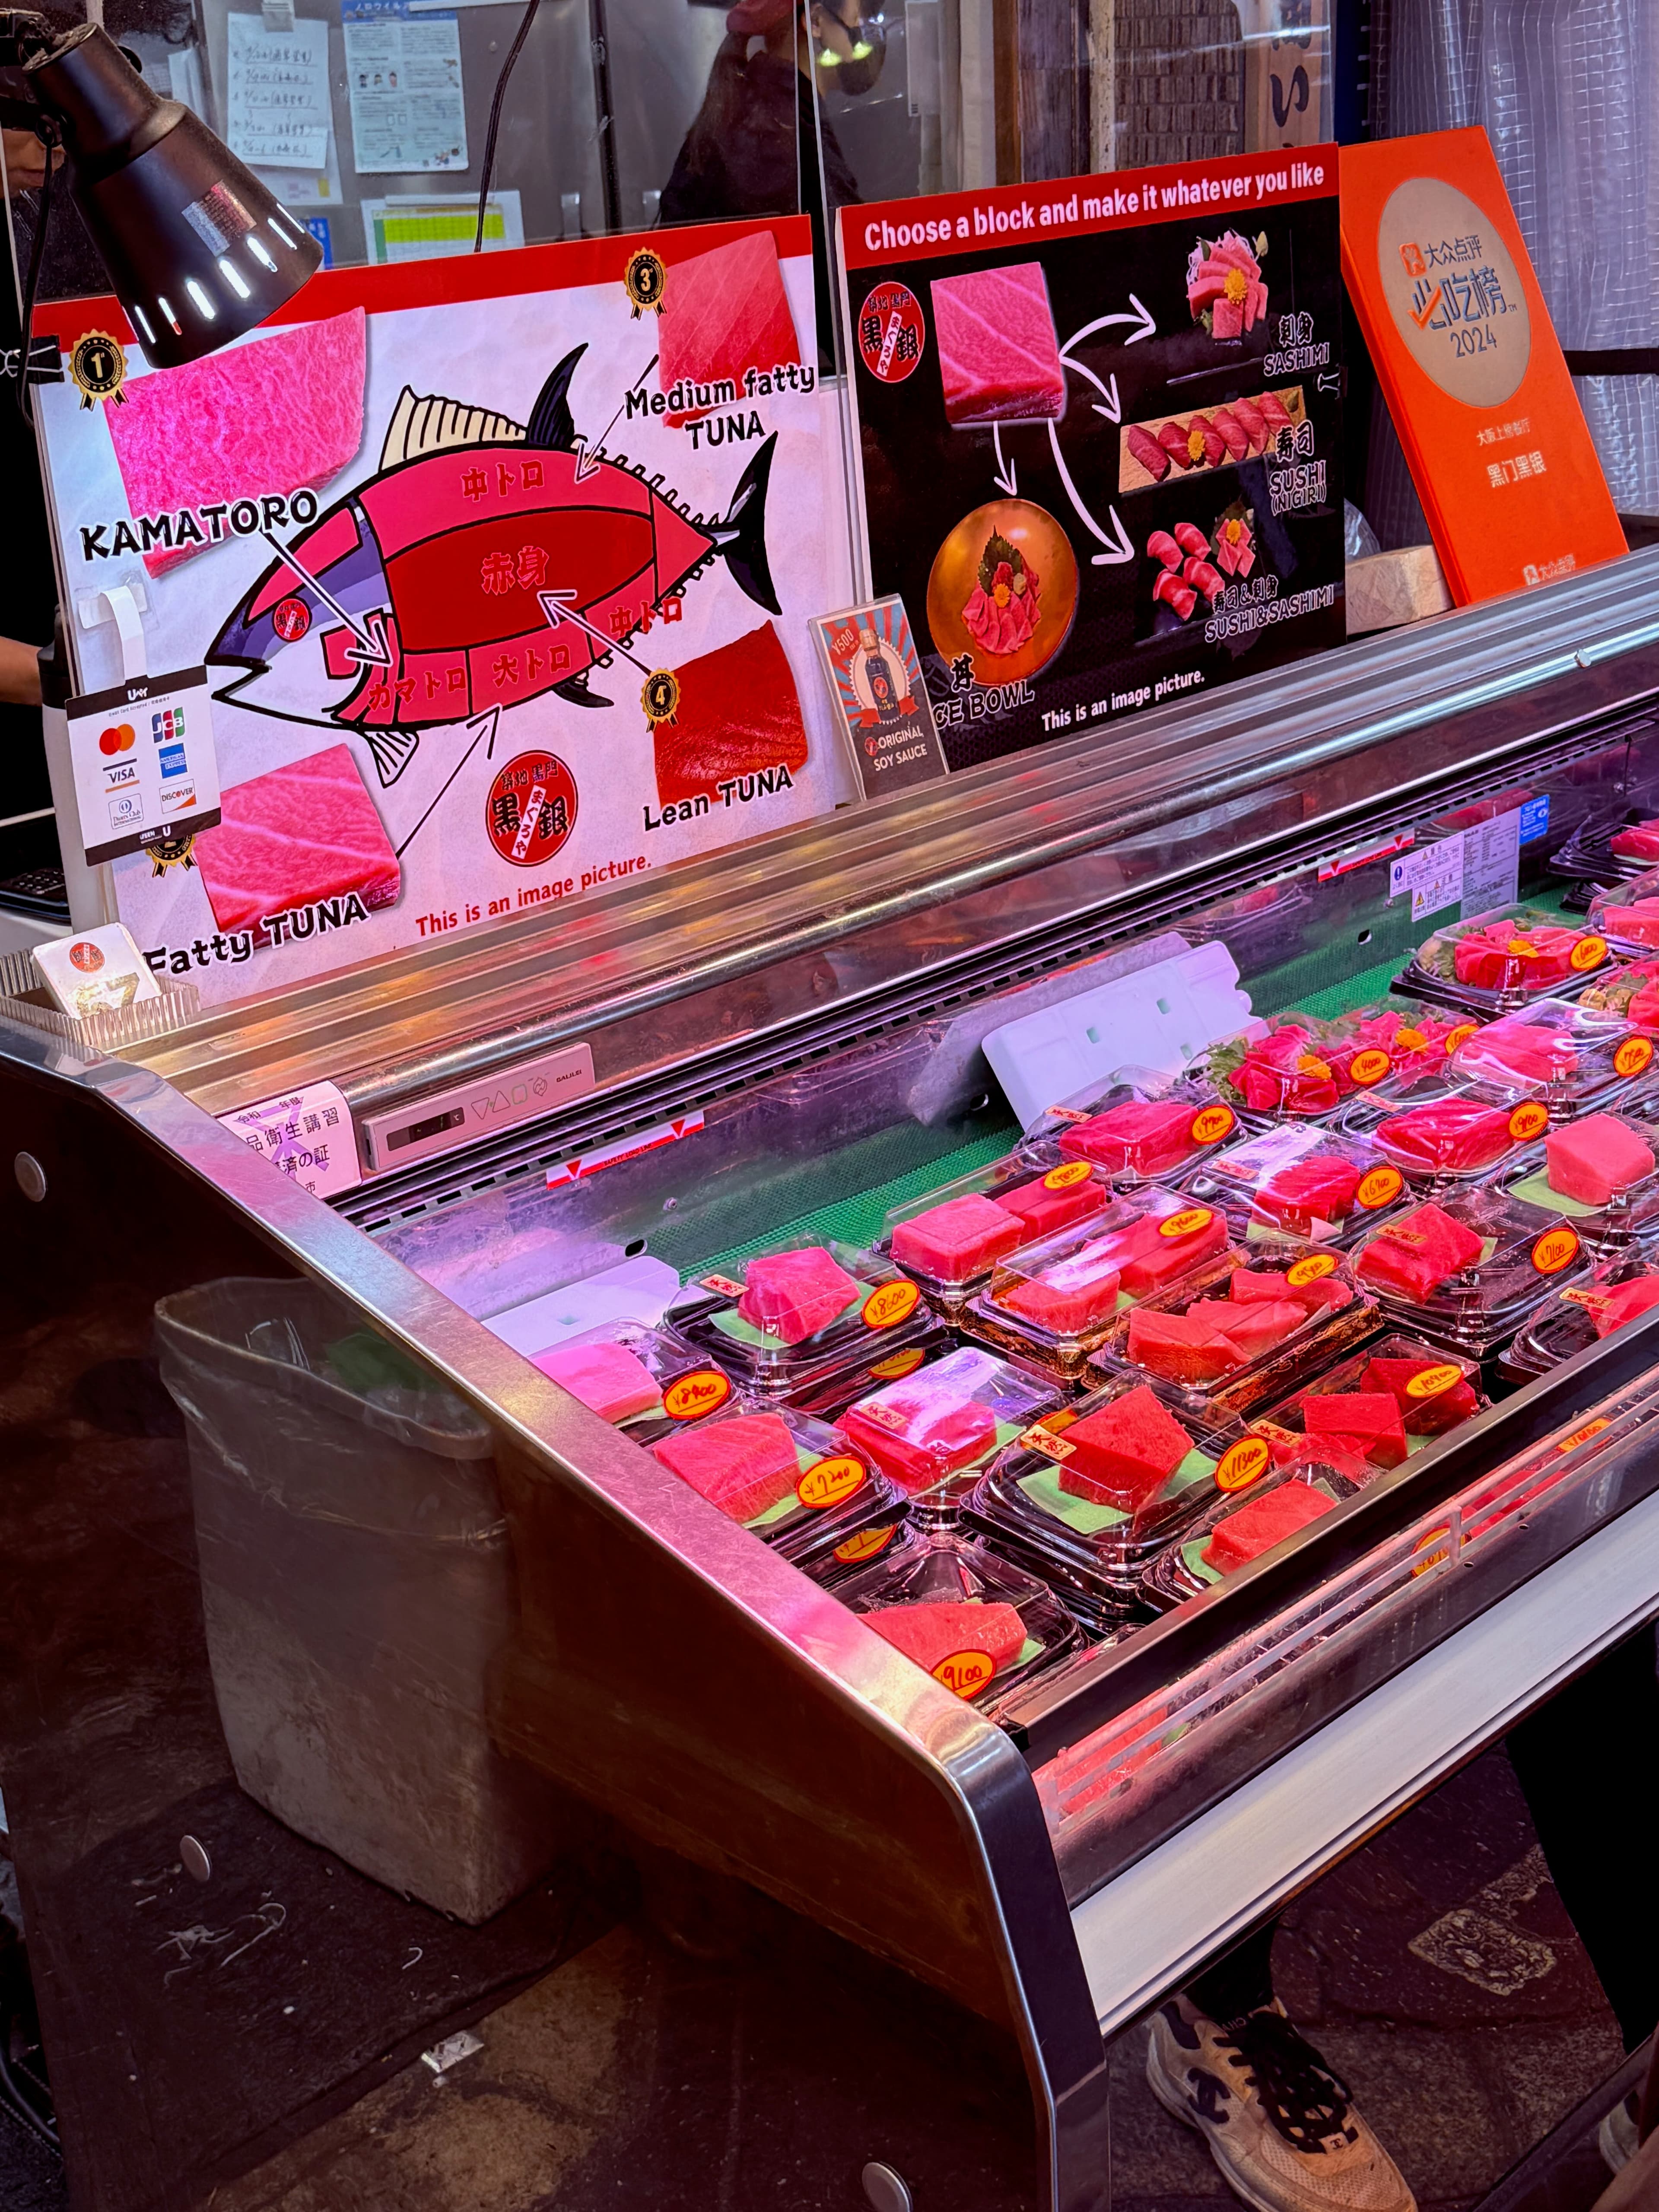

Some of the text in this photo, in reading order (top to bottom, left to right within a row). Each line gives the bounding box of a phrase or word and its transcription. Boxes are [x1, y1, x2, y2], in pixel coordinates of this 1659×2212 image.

[356, 2, 409, 11] ノロウイル
[865, 162, 1325, 252] Choose a block and make it whatever you like
[1424, 235, 1482, 268] 大众点评
[1407, 265, 1506, 330] 必吃榜
[880, 316, 899, 374] まぐろや
[1279, 311, 1313, 347] 刺身
[1450, 324, 1497, 358] 2024
[1263, 343, 1330, 377] SASHIMI
[626, 366, 815, 419] Medium fatty
[685, 410, 766, 449] TUNA
[1276, 420, 1314, 463] 寿司
[462, 460, 544, 502] 中トロ
[1269, 459, 1327, 496] SUSHI
[1271, 485, 1327, 517] (NIGIRI)
[79, 490, 318, 561] KAMATORO
[480, 546, 550, 595] 赤身
[609, 597, 683, 637] 中トロ
[1205, 584, 1335, 644] SUSHI&SASHIMI
[492, 644, 571, 688] 大トロ
[368, 668, 467, 711] カマトロ
[969, 678, 1036, 718] BOWL
[1042, 668, 1205, 731] This is an image picture.
[877, 725, 924, 749] ORIGINAL
[108, 767, 135, 783] VISA
[874, 753, 894, 772] SOY
[896, 743, 928, 765] SAUCE
[161, 787, 194, 802] DISCOVER
[642, 768, 794, 832] Lean TUNA
[516, 790, 543, 855] まぐろや
[416, 853, 652, 937] This is an image picture.
[142, 933, 253, 975] Fatty
[261, 893, 369, 947] TUNA
[556, 1069, 582, 1083] GALILEI
[1354, 1057, 1381, 1075] ¥4000
[238, 1111, 261, 1123] 令和
[246, 1107, 339, 1151] 品衛生講習
[275, 1144, 330, 1175] 済の証
[870, 1288, 906, 1319] ¥8600
[804, 1466, 851, 1496] ¥7200
[1223, 1447, 1262, 1480] ¥11300
